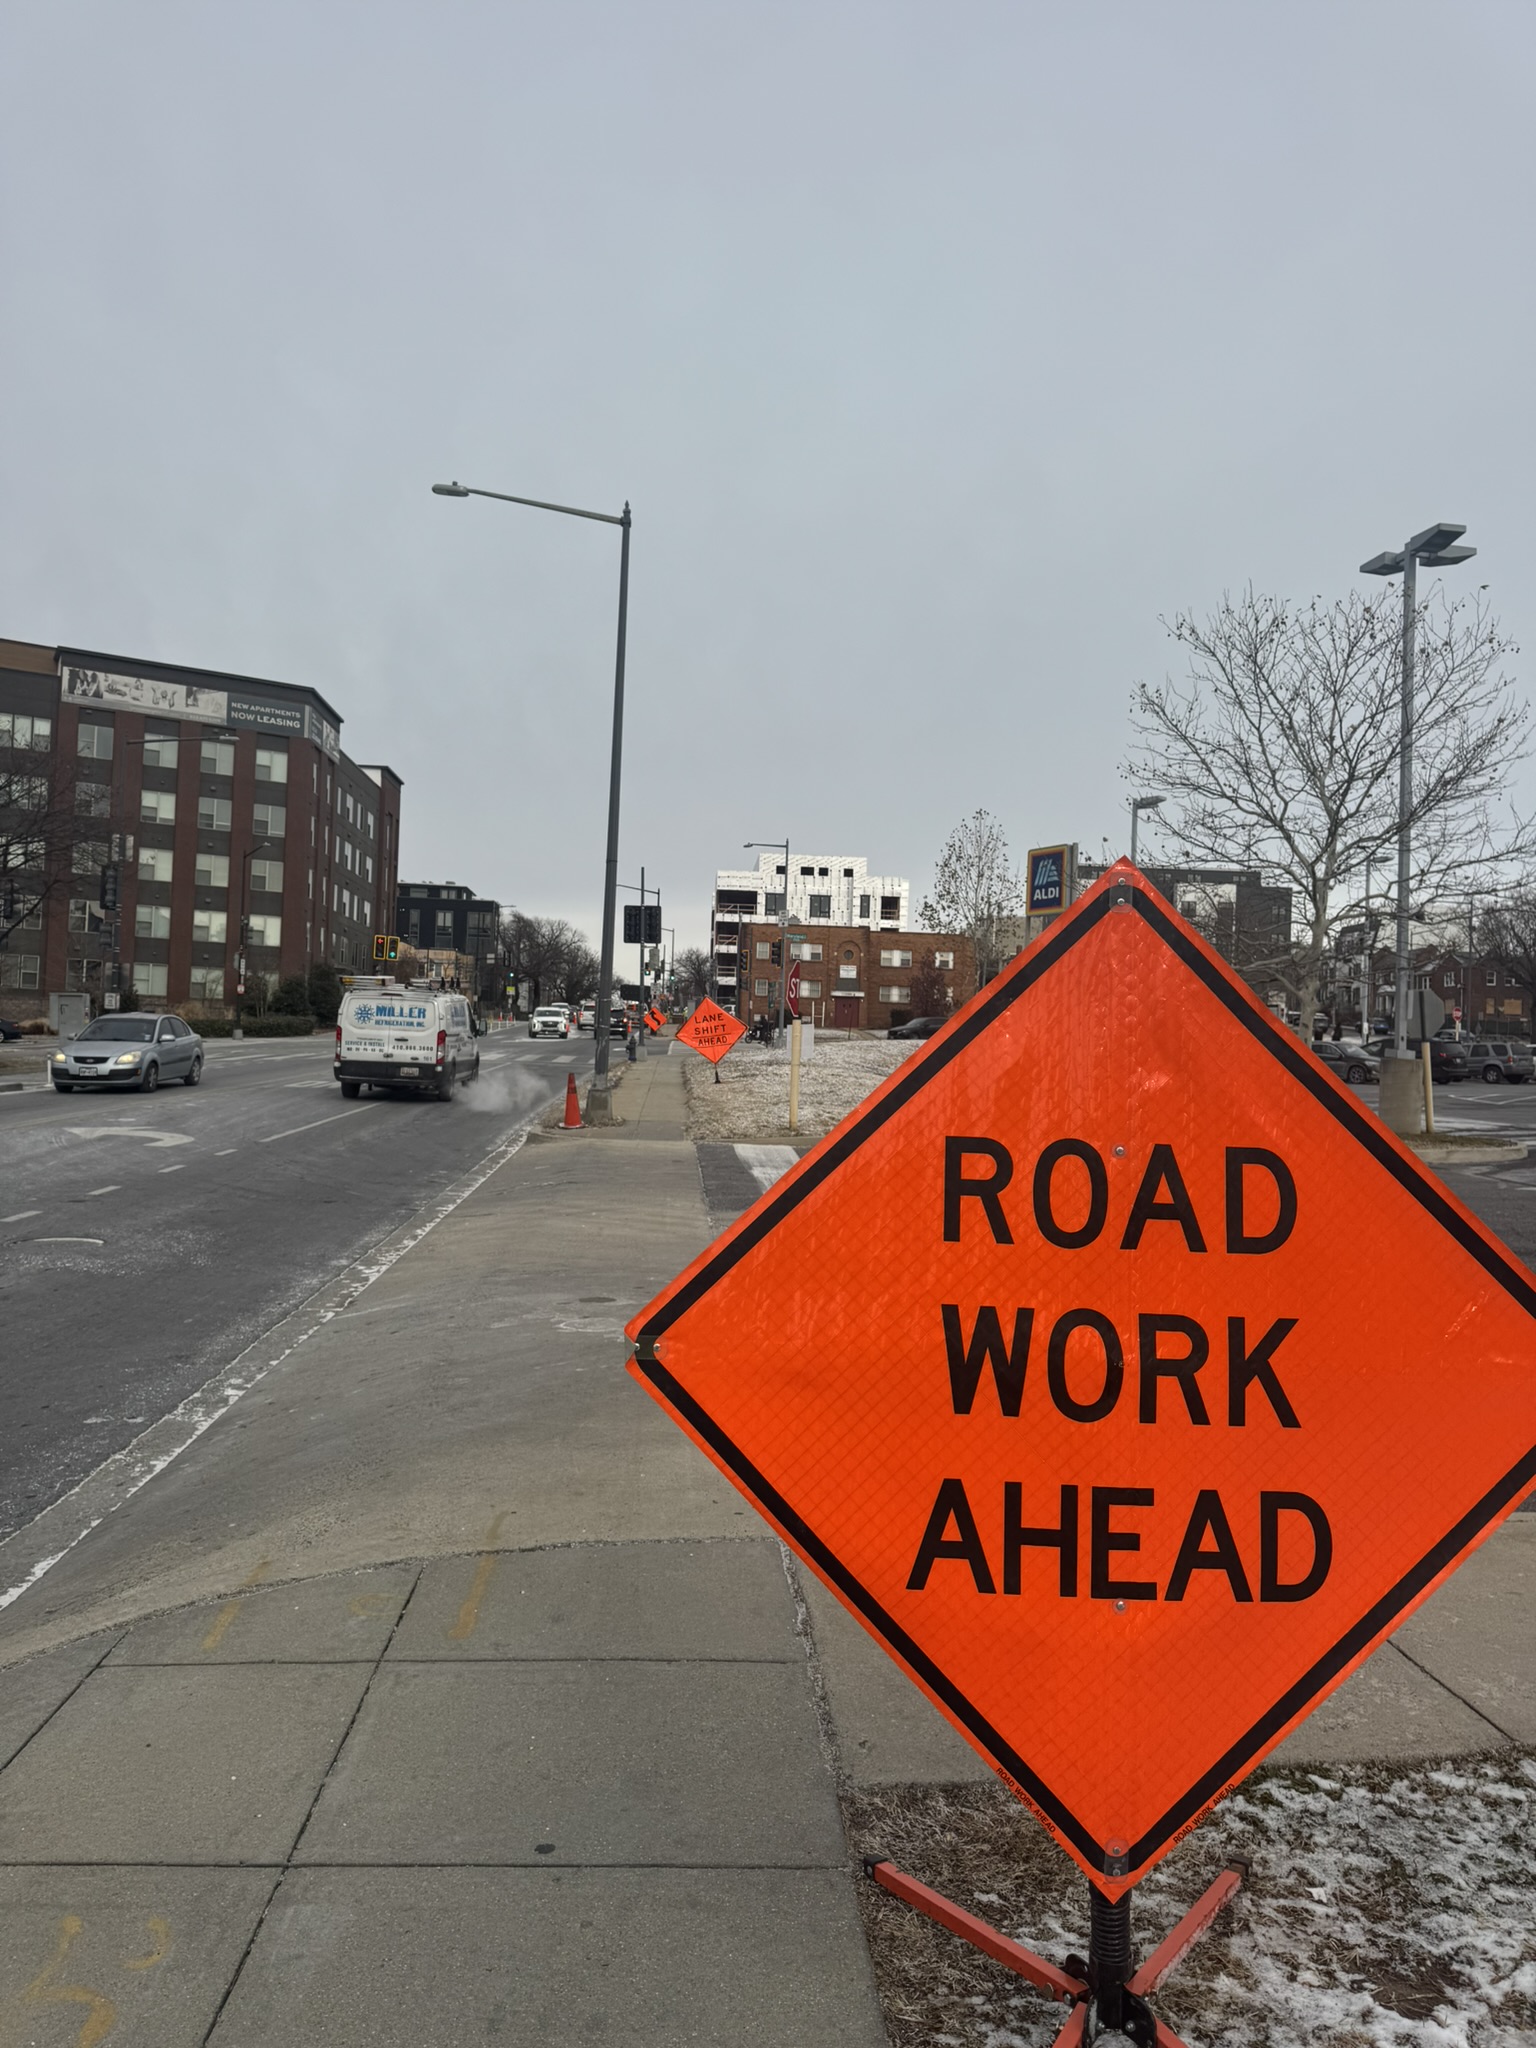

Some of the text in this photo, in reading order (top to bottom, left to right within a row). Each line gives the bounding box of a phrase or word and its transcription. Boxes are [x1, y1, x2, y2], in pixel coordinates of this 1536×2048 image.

[231, 701, 301, 718] NEW APARTMENTS
[231, 711, 255, 721] NOW
[257, 715, 301, 729] LEASING
[1033, 886, 1059, 901] ALDI
[376, 1005, 426, 1019] MILLER
[694, 1012, 724, 1024] LANE
[694, 1024, 727, 1036] SHIFT
[698, 1035, 728, 1047] AHEAD
[942, 1135, 1299, 1255] ROAD
[940, 1303, 1302, 1429] WORK
[905, 1477, 1333, 1603] AHEAD
[996, 1767, 1056, 1833] ROAD WORK AHEAD
[1172, 1783, 1235, 1844] ROAD WORK AHEAD
